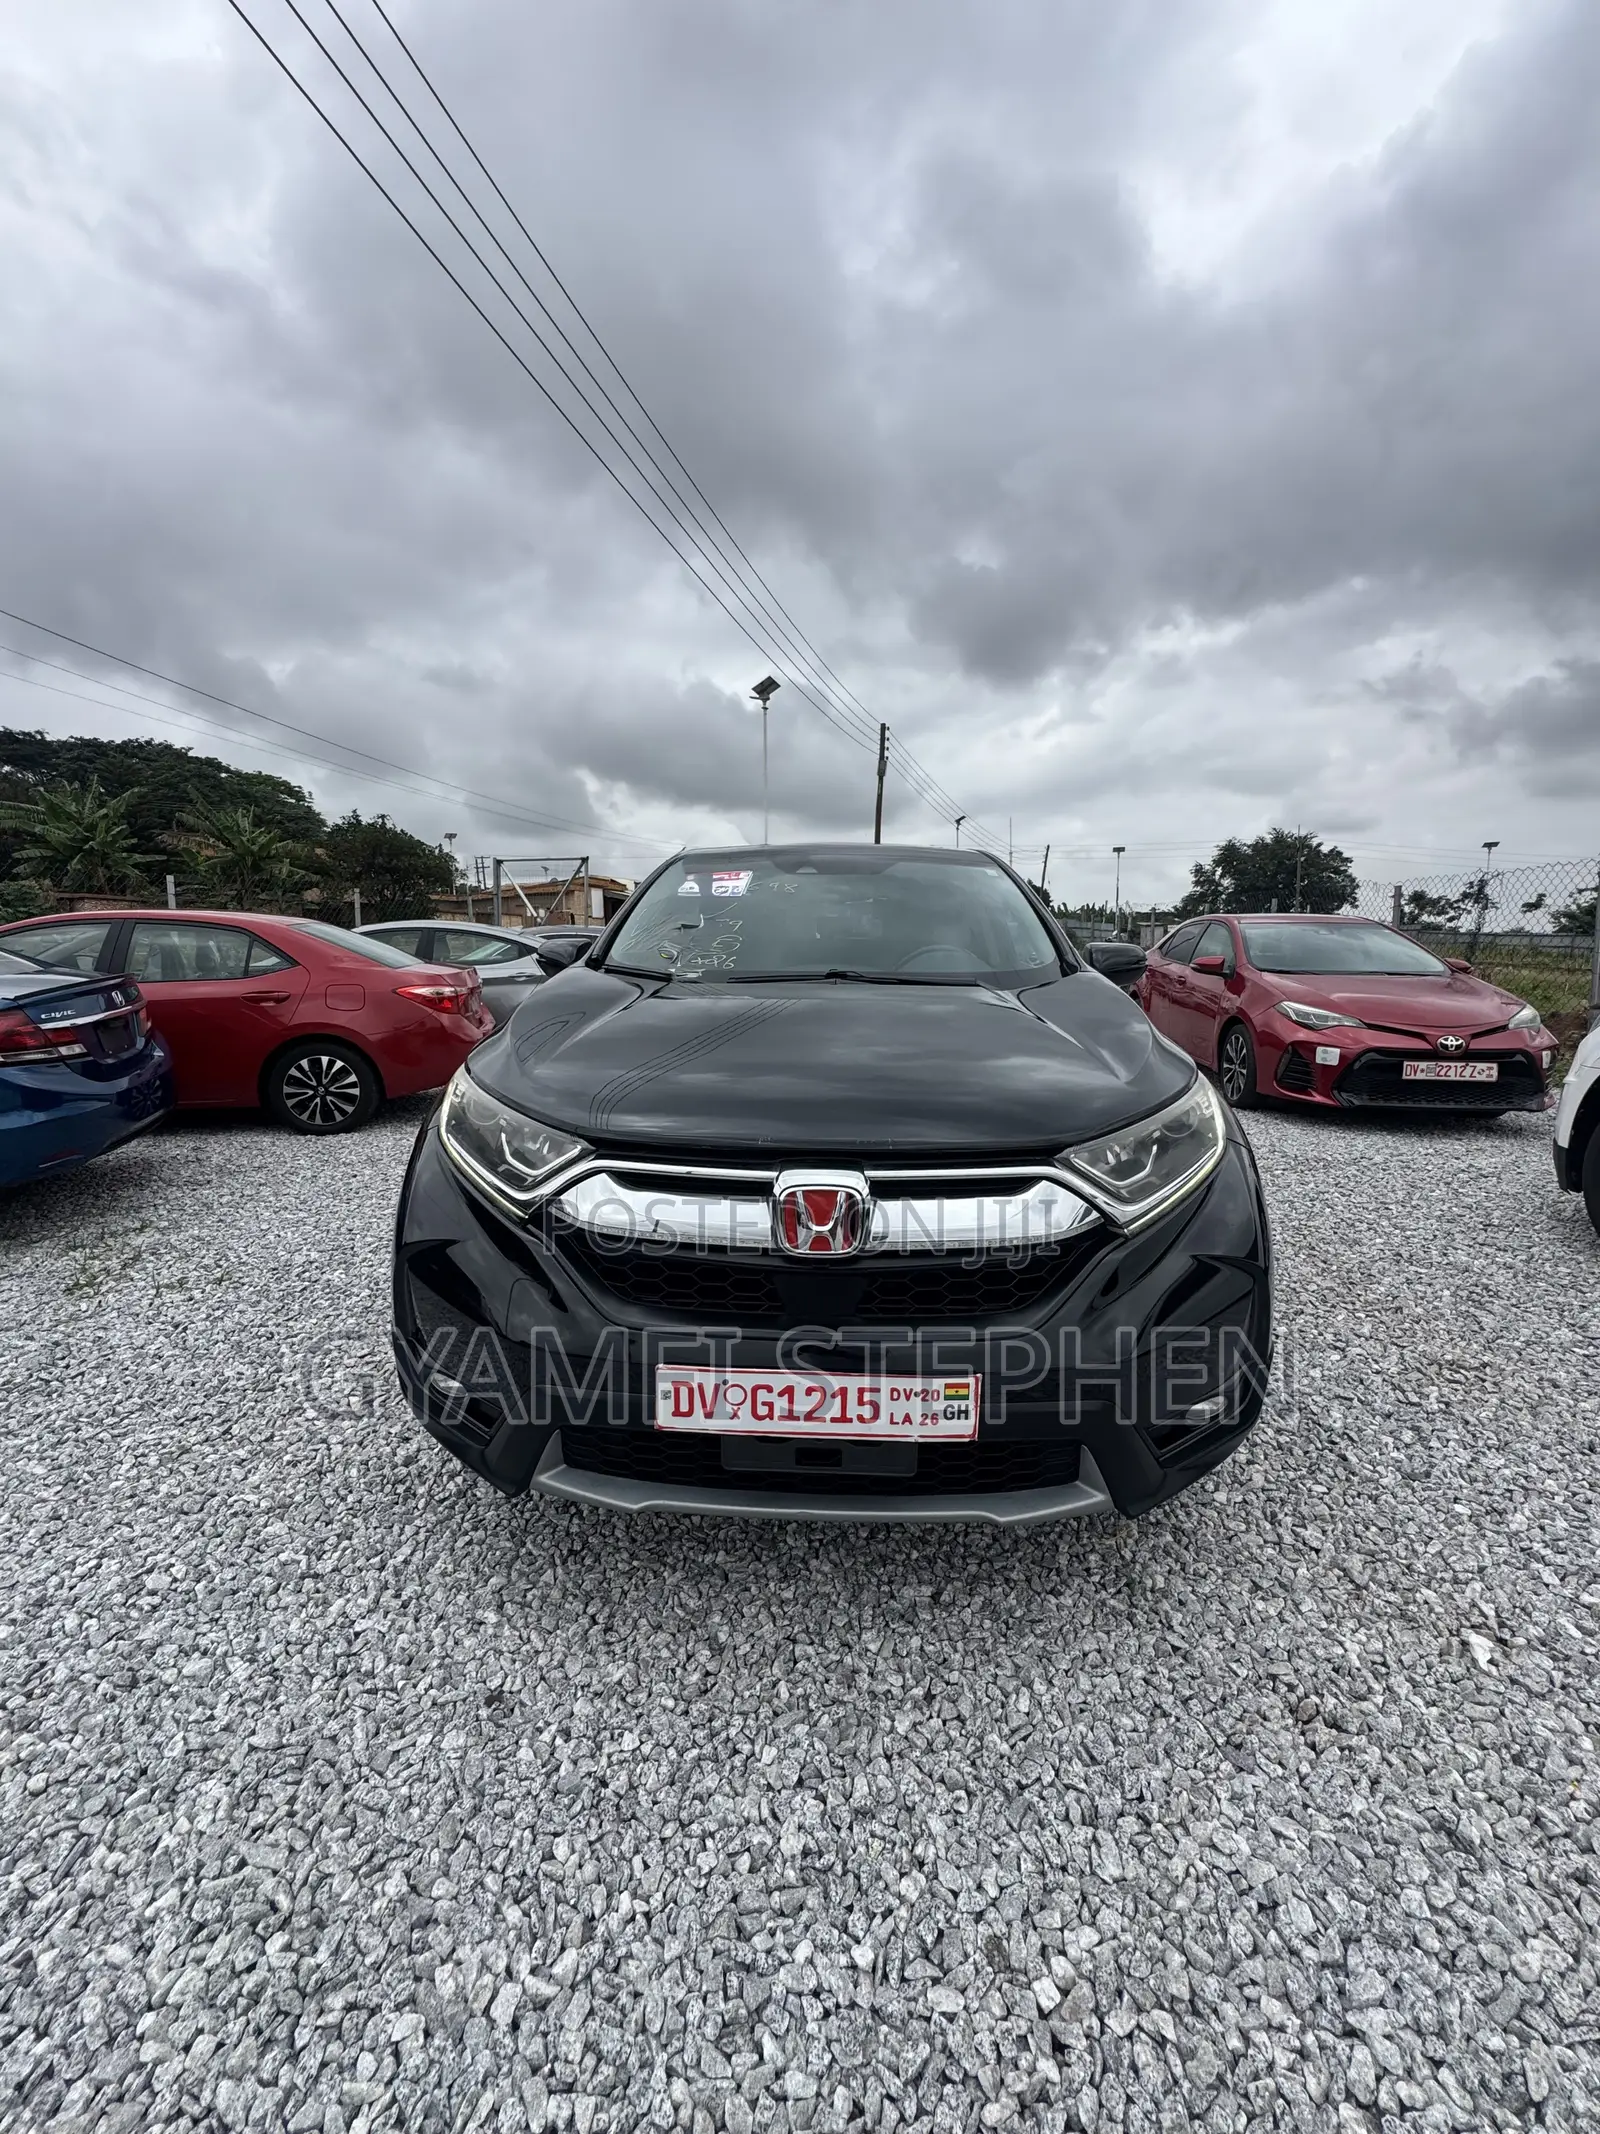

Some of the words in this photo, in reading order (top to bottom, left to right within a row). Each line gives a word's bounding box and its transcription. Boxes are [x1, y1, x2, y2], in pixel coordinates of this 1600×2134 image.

[40, 1009, 76, 1019] CIVIC
[1405, 1064, 1419, 1077] DV
[670, 1380, 721, 1420] DV
[750, 1383, 881, 1424] G1215
[889, 1412, 913, 1426] LA
[918, 1412, 939, 1427] 26
[942, 1404, 970, 1421] GH
